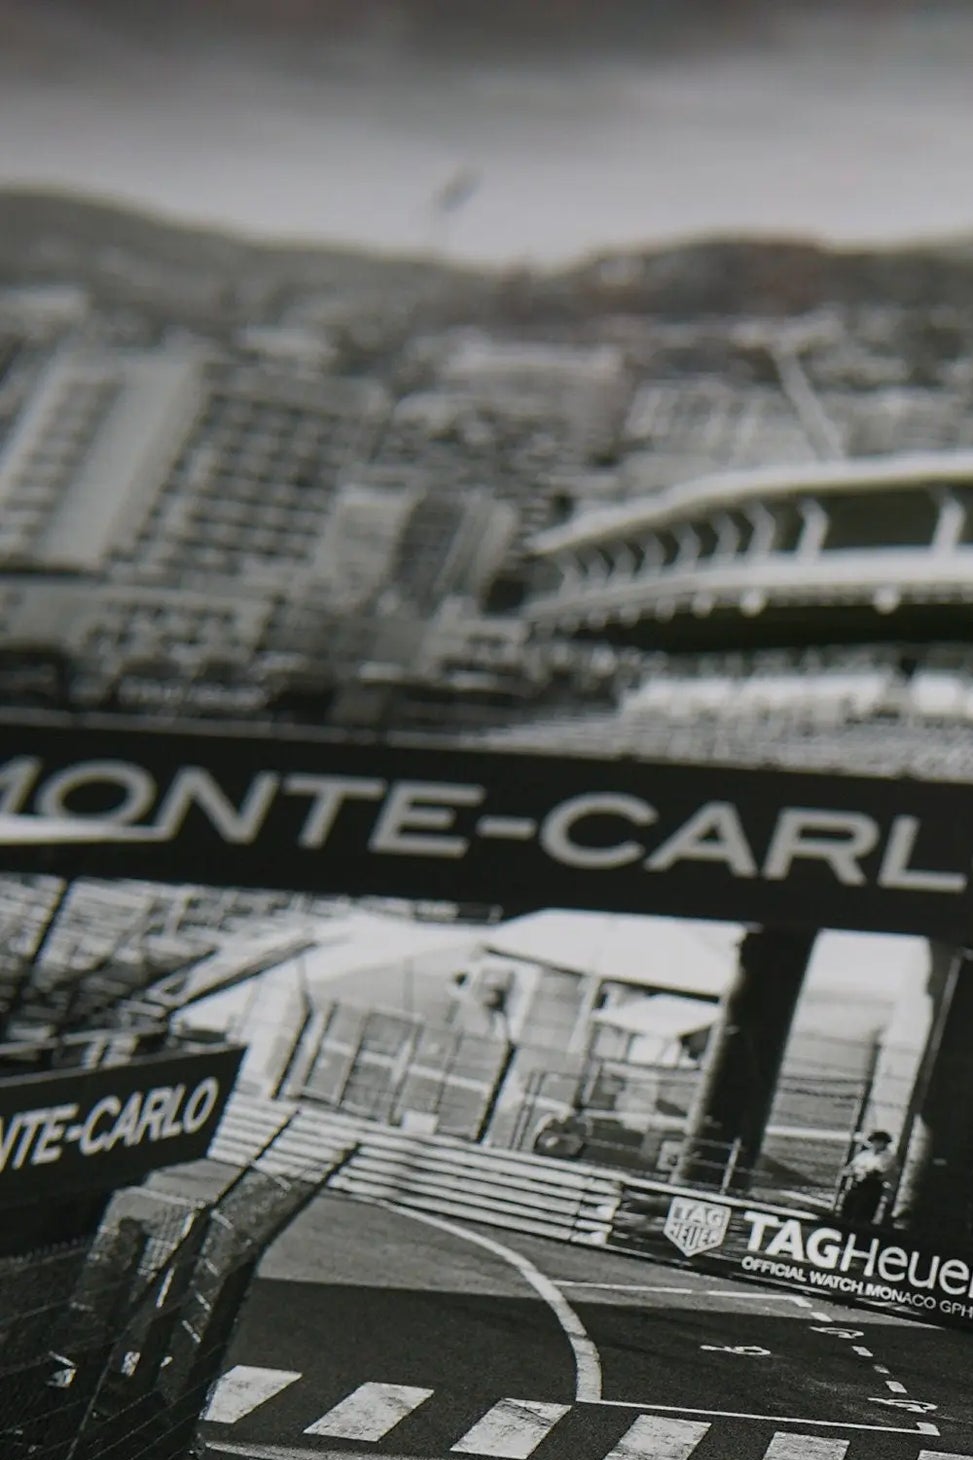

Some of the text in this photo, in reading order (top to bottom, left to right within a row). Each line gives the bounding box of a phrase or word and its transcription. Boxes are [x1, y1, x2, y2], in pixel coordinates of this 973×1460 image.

[741, 1255, 807, 1282] OFFICIAL
[809, 1270, 864, 1295] WATCH
[864, 1283, 937, 1310] MONACO
